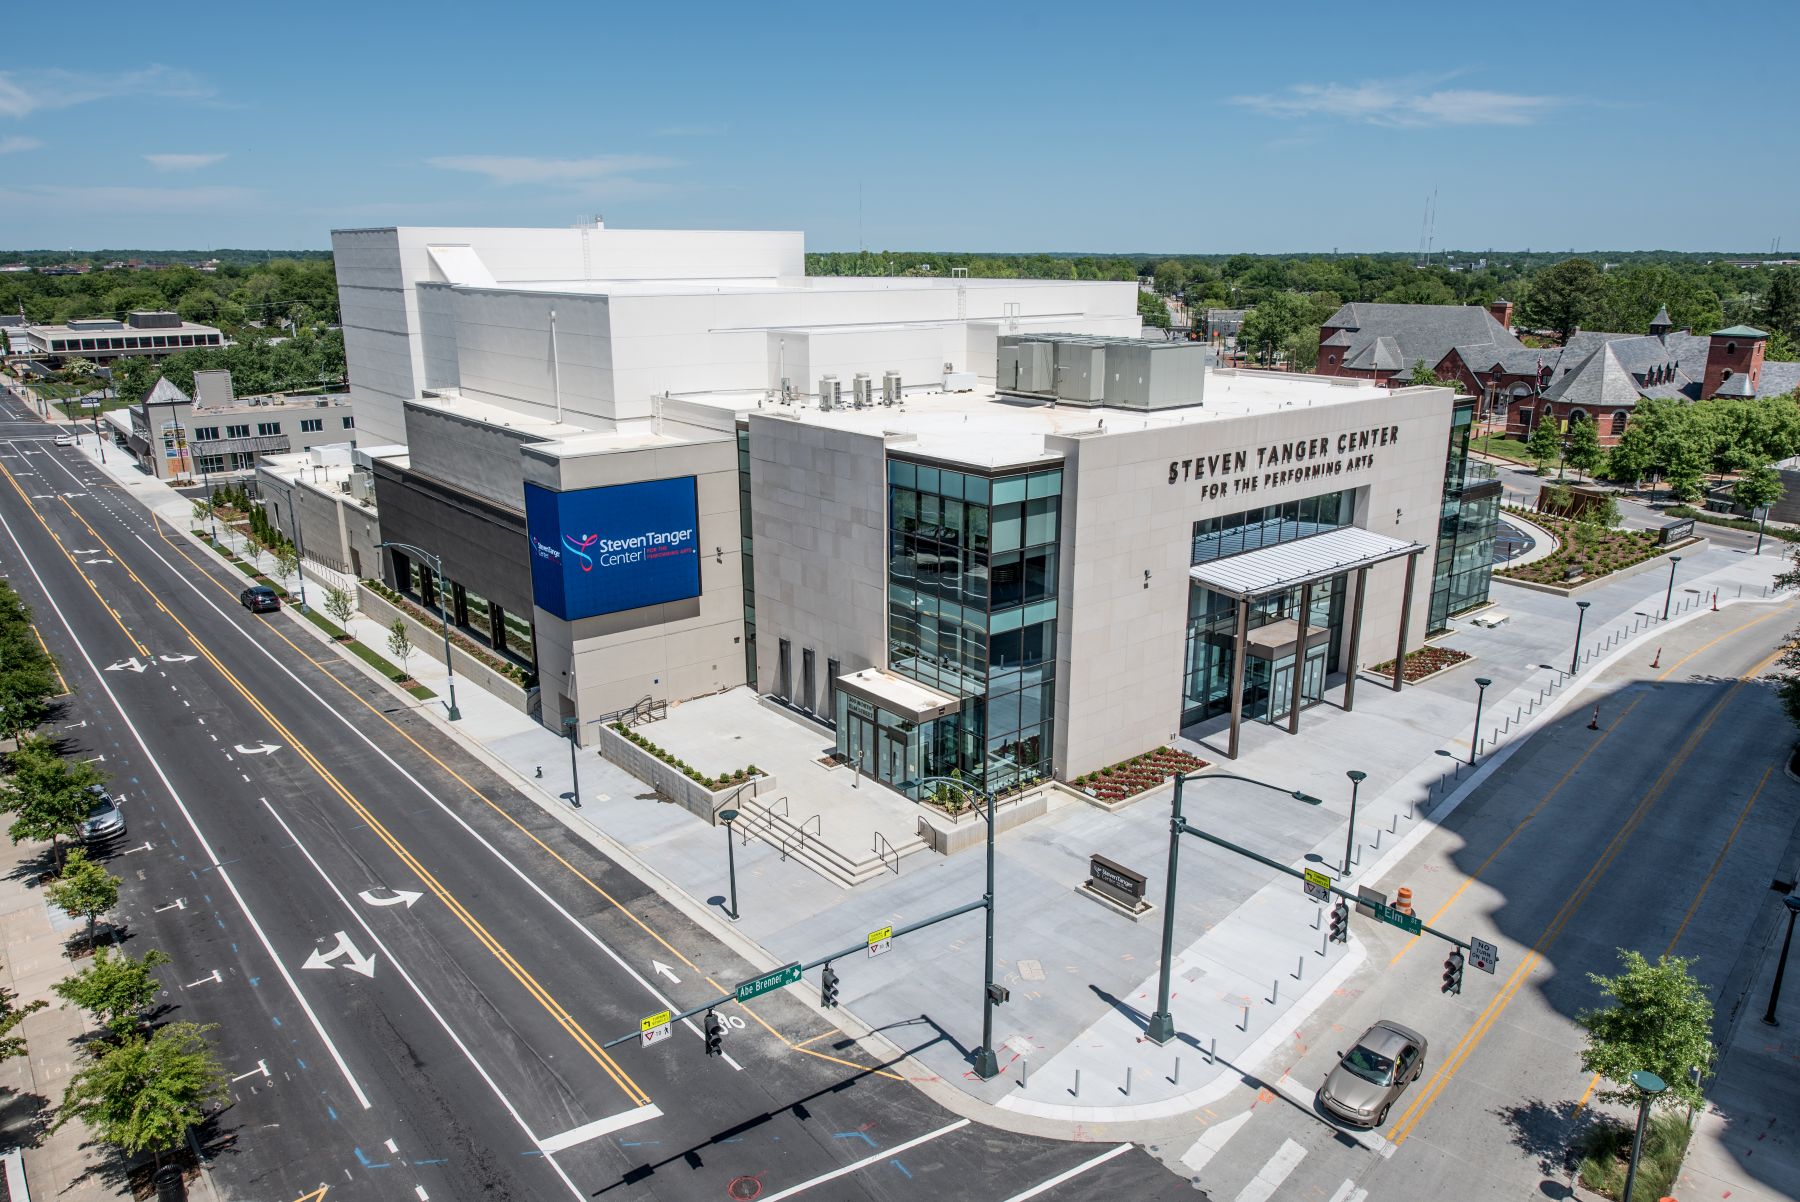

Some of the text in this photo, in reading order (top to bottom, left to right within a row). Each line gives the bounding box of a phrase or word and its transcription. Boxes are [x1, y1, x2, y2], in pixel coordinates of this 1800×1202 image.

[1168, 425, 1399, 484] STEVEN TANGER CENTER
[1201, 454, 1374, 501] FOR THE PERFORMING ARTS
[600, 551, 642, 567] Center
[1384, 907, 1403, 924] Elm
[1476, 948, 1491, 958] TURN
[1478, 942, 1490, 951] NO
[1471, 952, 1493, 965] ON RED
[740, 985, 754, 998] Abe
[755, 974, 783, 992] Brenner
